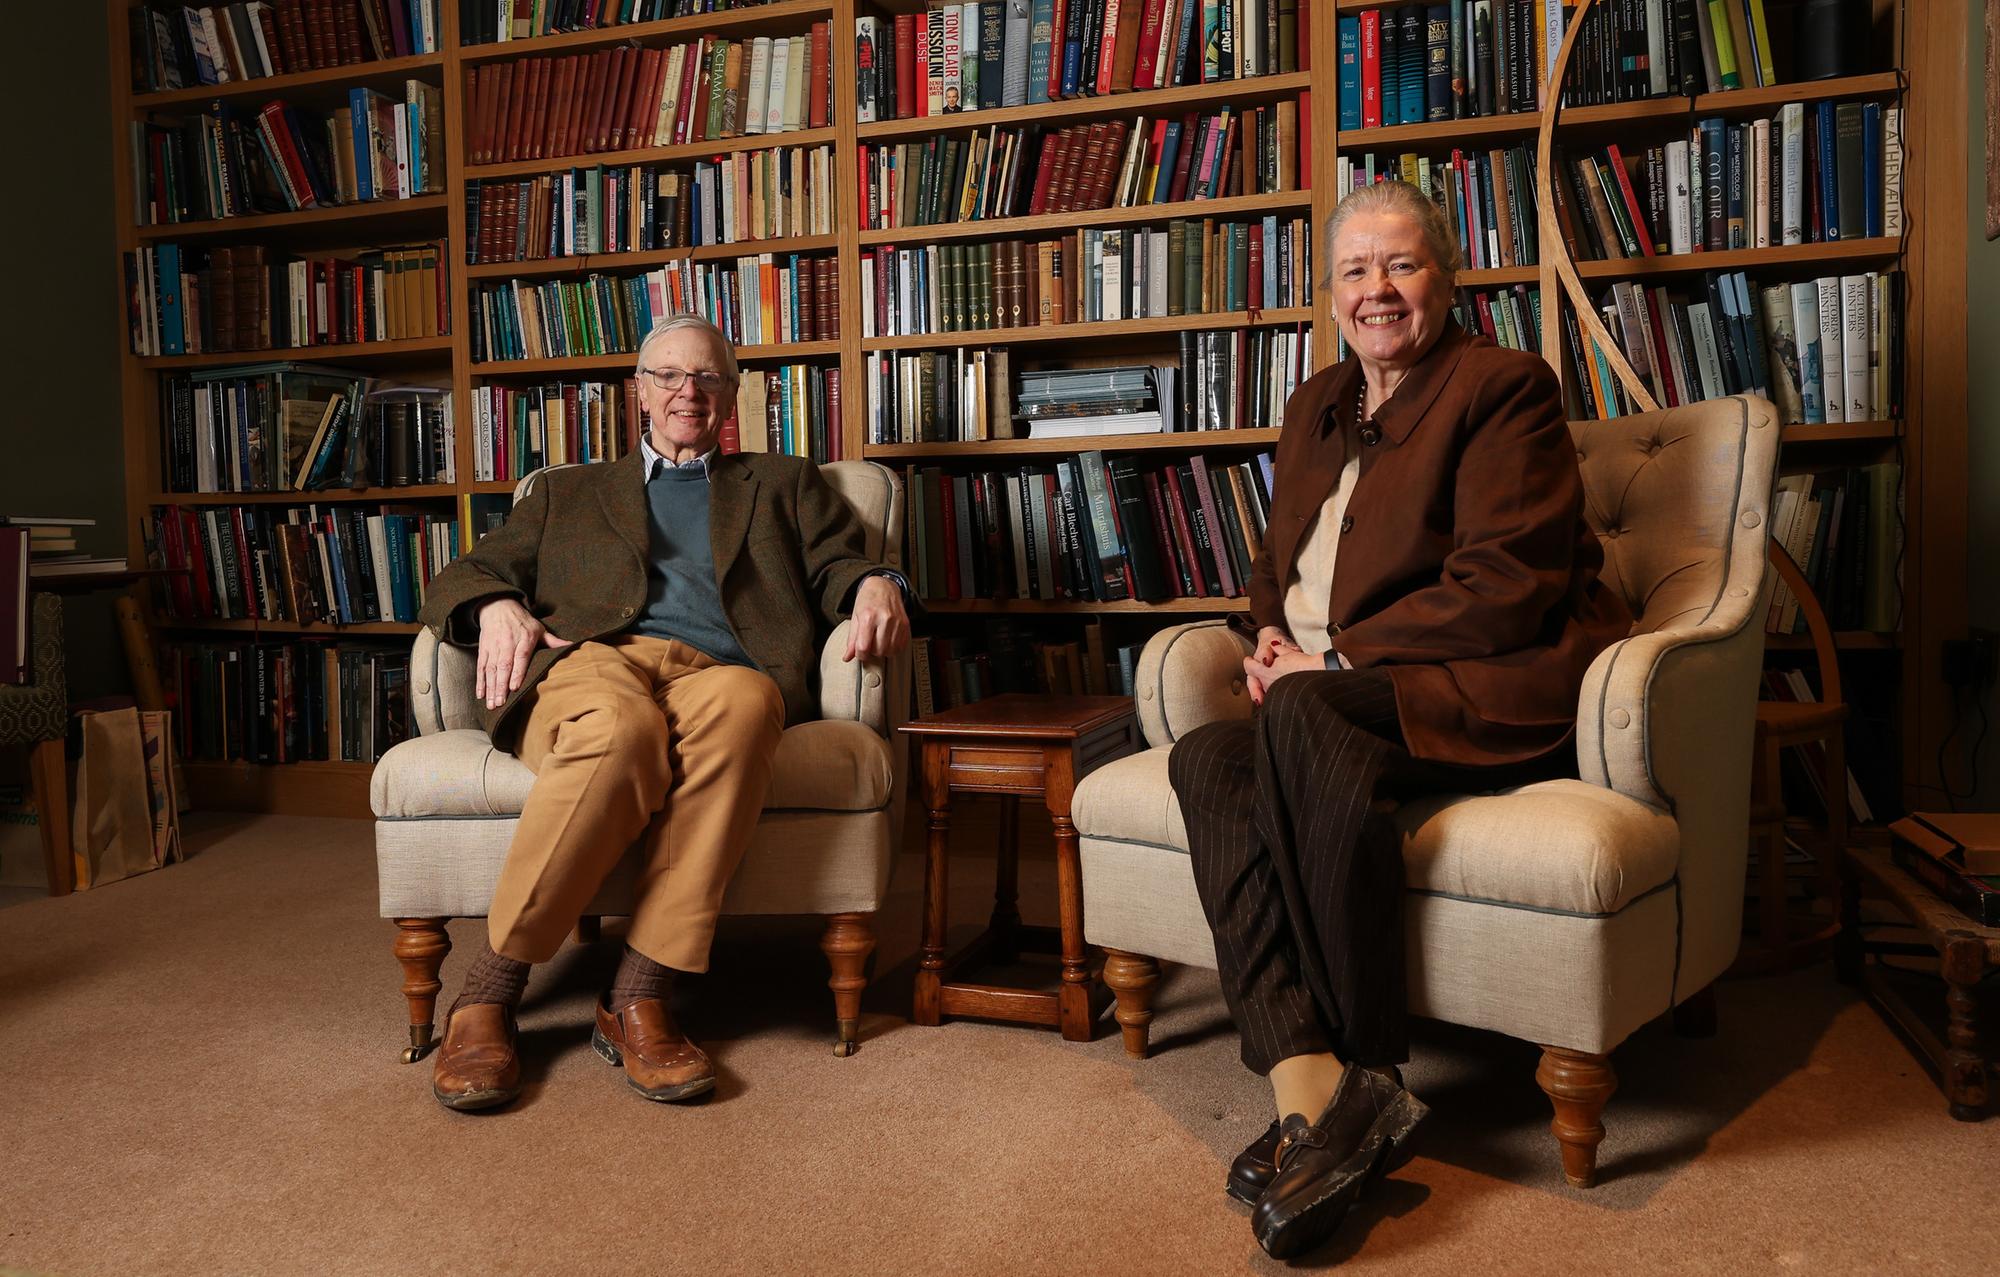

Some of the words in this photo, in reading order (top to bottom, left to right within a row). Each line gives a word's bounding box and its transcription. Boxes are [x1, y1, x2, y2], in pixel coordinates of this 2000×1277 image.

[1104, 0, 1120, 39] SOMME
[1523, 5, 1531, 14] The
[1549, 0, 1558, 17] THE
[945, 13, 959, 41] TONY
[1524, 15, 1532, 32] Oxford
[1550, 20, 1559, 49] CROSS
[917, 32, 927, 64] DUSE
[929, 12, 943, 79] MUSSOLINI
[1221, 31, 1232, 54] PQ17
[1510, 20, 1518, 60] MEDIEVAL
[1523, 33, 1533, 57] Dictionary
[712, 48, 725, 101] SCHAMA
[945, 45, 959, 78] BLAIR
[1511, 61, 1519, 100] TREASURY
[1889, 113, 1897, 128] The
[1734, 130, 1742, 152] BRITISH
[1772, 127, 1780, 147] DUFFY
[1655, 148, 1664, 165] Hall's
[1759, 138, 1768, 179] Understanding
[1787, 133, 1800, 177] Christian
[1267, 161, 1275, 179] Lewis
[1647, 161, 1656, 183] Images
[1655, 166, 1665, 187] History
[1734, 154, 1742, 201] WATERCOLOURS
[1772, 156, 1780, 184] MARKING
[1886, 131, 1899, 229] ATHENÆUM
[1706, 151, 1722, 219] COLOUR
[1772, 185, 1780, 199] THE
[1788, 179, 1800, 195] Art
[1650, 192, 1658, 210] Italian
[1658, 195, 1666, 211] Ideas
[1772, 200, 1780, 223] HOURS
[1501, 297, 1513, 326] TURNER
[1533, 298, 1543, 334] SARGEN
[1637, 292, 1649, 325] CONSTABLE
[1821, 285, 1831, 333] PAINTERS
[1829, 284, 1839, 342] VICTORIAN
[1848, 284, 1857, 332] PAINTERS
[1857, 283, 1865, 341] VICTORIAN
[481, 412, 490, 448] CARUSO
[1063, 491, 1075, 511] Carl
[220, 522, 231, 536] THE
[1023, 505, 1033, 531] PICTURE
[1066, 513, 1080, 550] Blechen
[1094, 494, 1112, 551] Mauritshuis
[1197, 509, 1211, 549] KENWOOD
[221, 536, 232, 555] LOVES
[227, 566, 237, 580] THE
[229, 580, 239, 598] GODS
